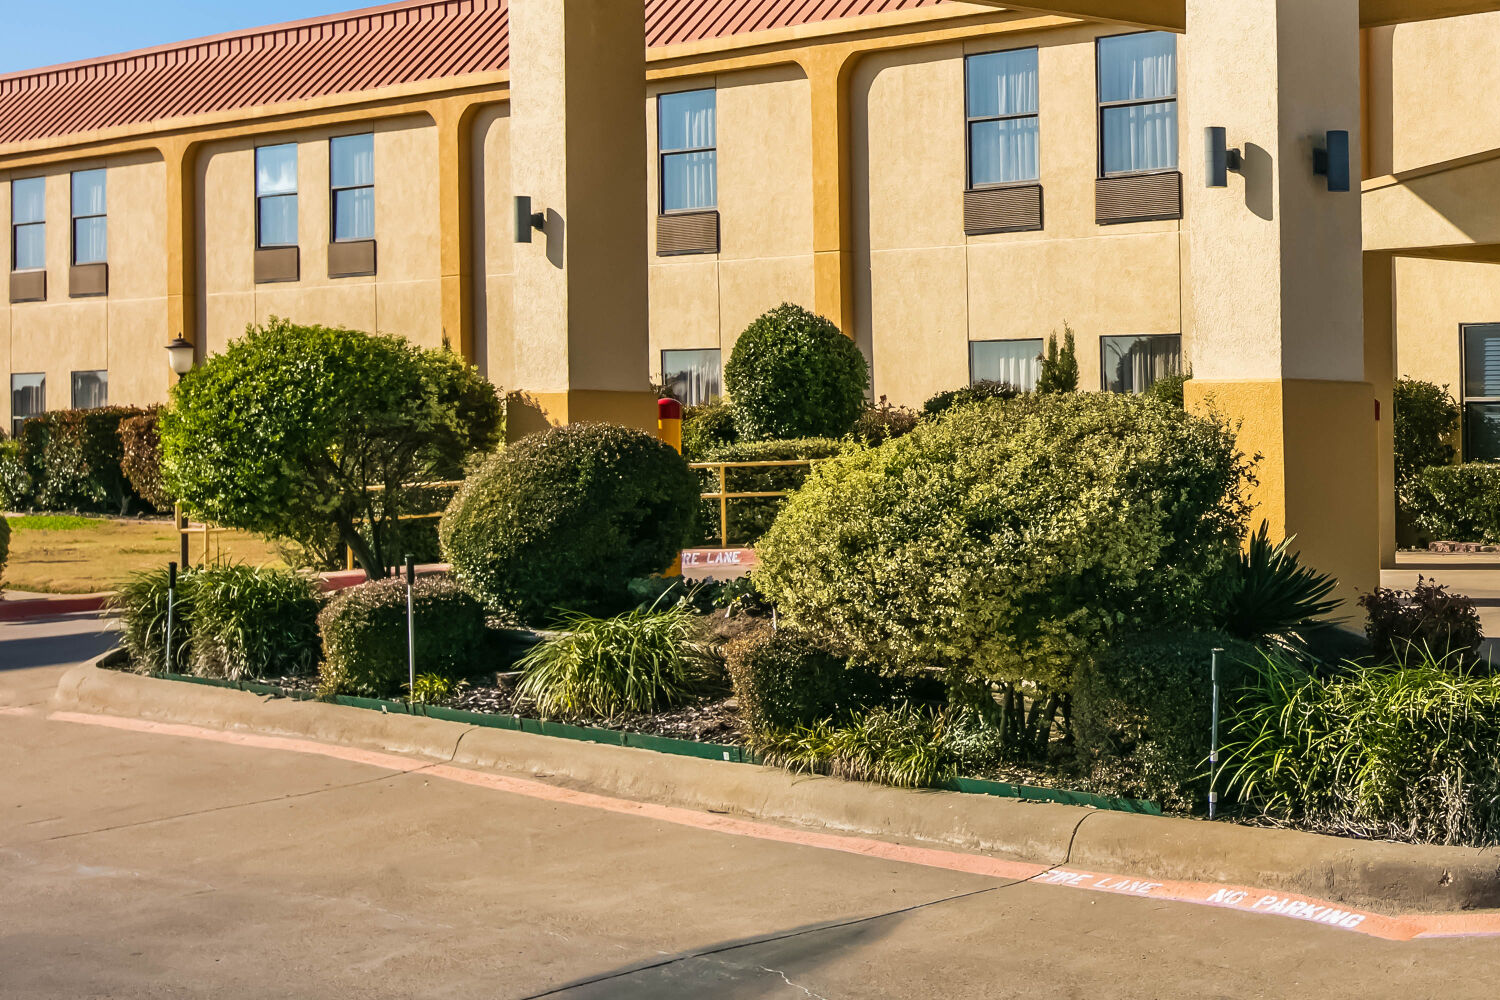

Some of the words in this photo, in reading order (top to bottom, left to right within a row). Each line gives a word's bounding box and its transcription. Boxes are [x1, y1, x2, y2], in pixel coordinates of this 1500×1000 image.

[706, 551, 741, 564] LANE
[1034, 869, 1094, 885] FIRE
[1093, 878, 1163, 894] LANE
[1206, 888, 1249, 904] NO
[1250, 895, 1366, 928] PARKING
